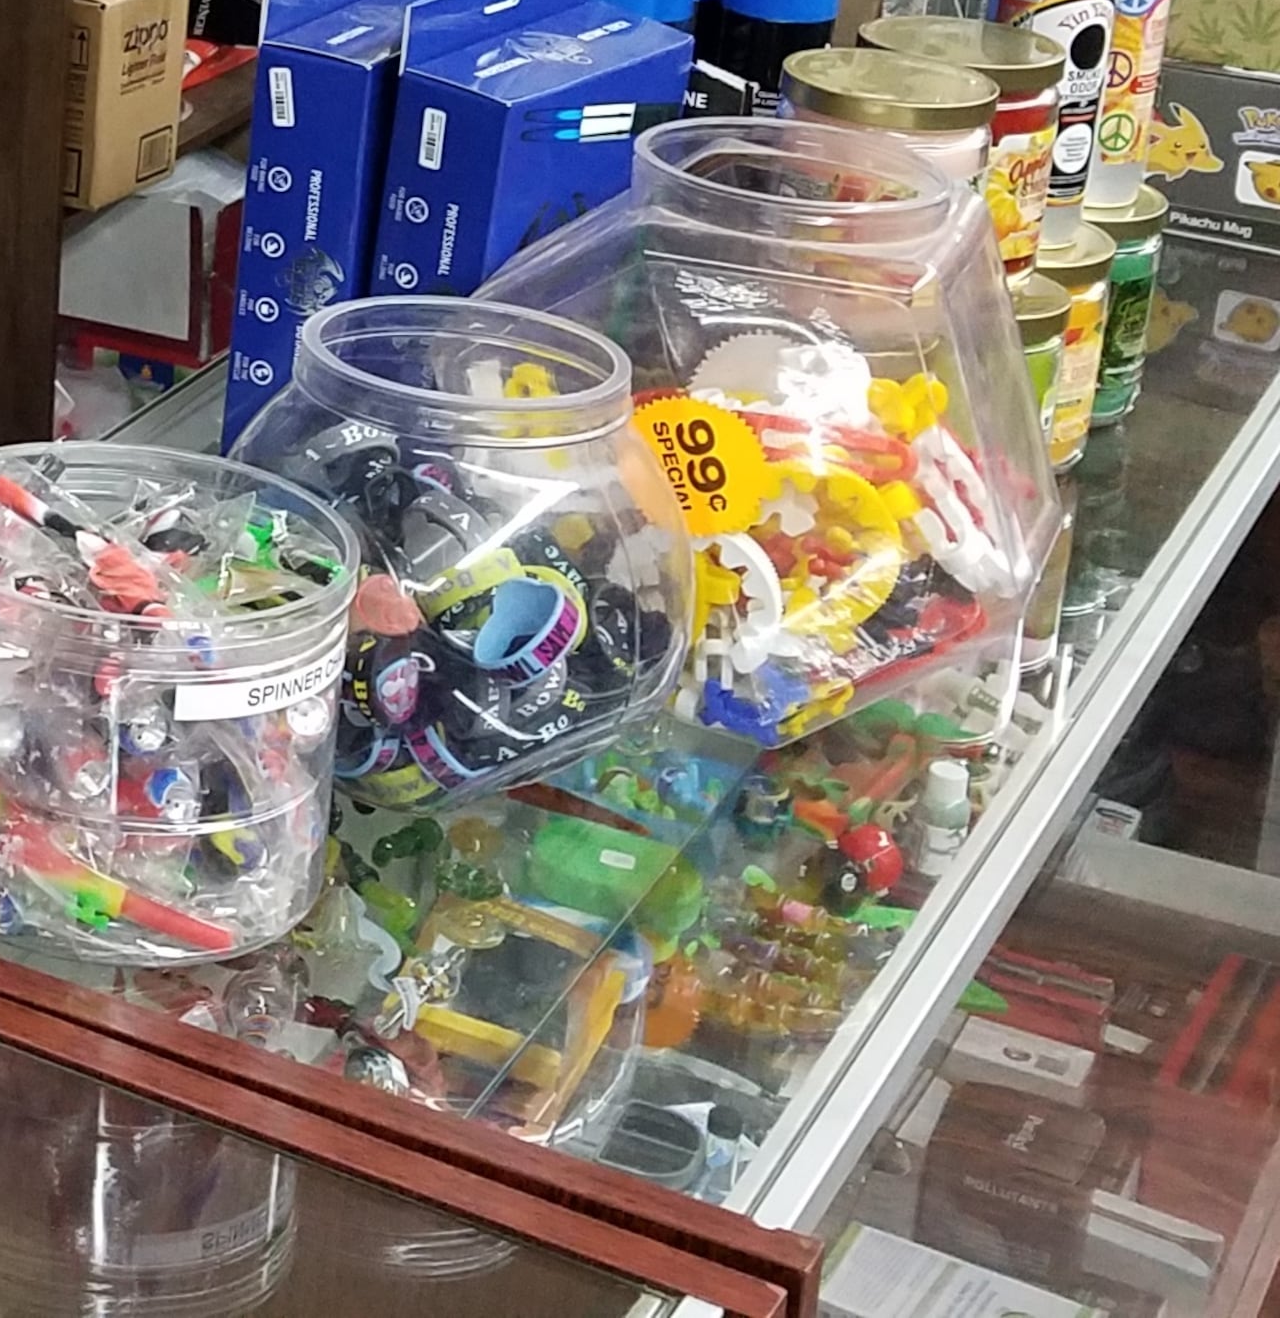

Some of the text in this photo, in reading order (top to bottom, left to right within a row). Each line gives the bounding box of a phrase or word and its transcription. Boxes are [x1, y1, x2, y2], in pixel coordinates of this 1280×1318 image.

[304, 168, 323, 242] PROFESSIONAL
[1169, 210, 1253, 240] Pikachu Mug
[436, 202, 460, 276] PROFESSIONAL
[247, 666, 323, 708] SPINNER
